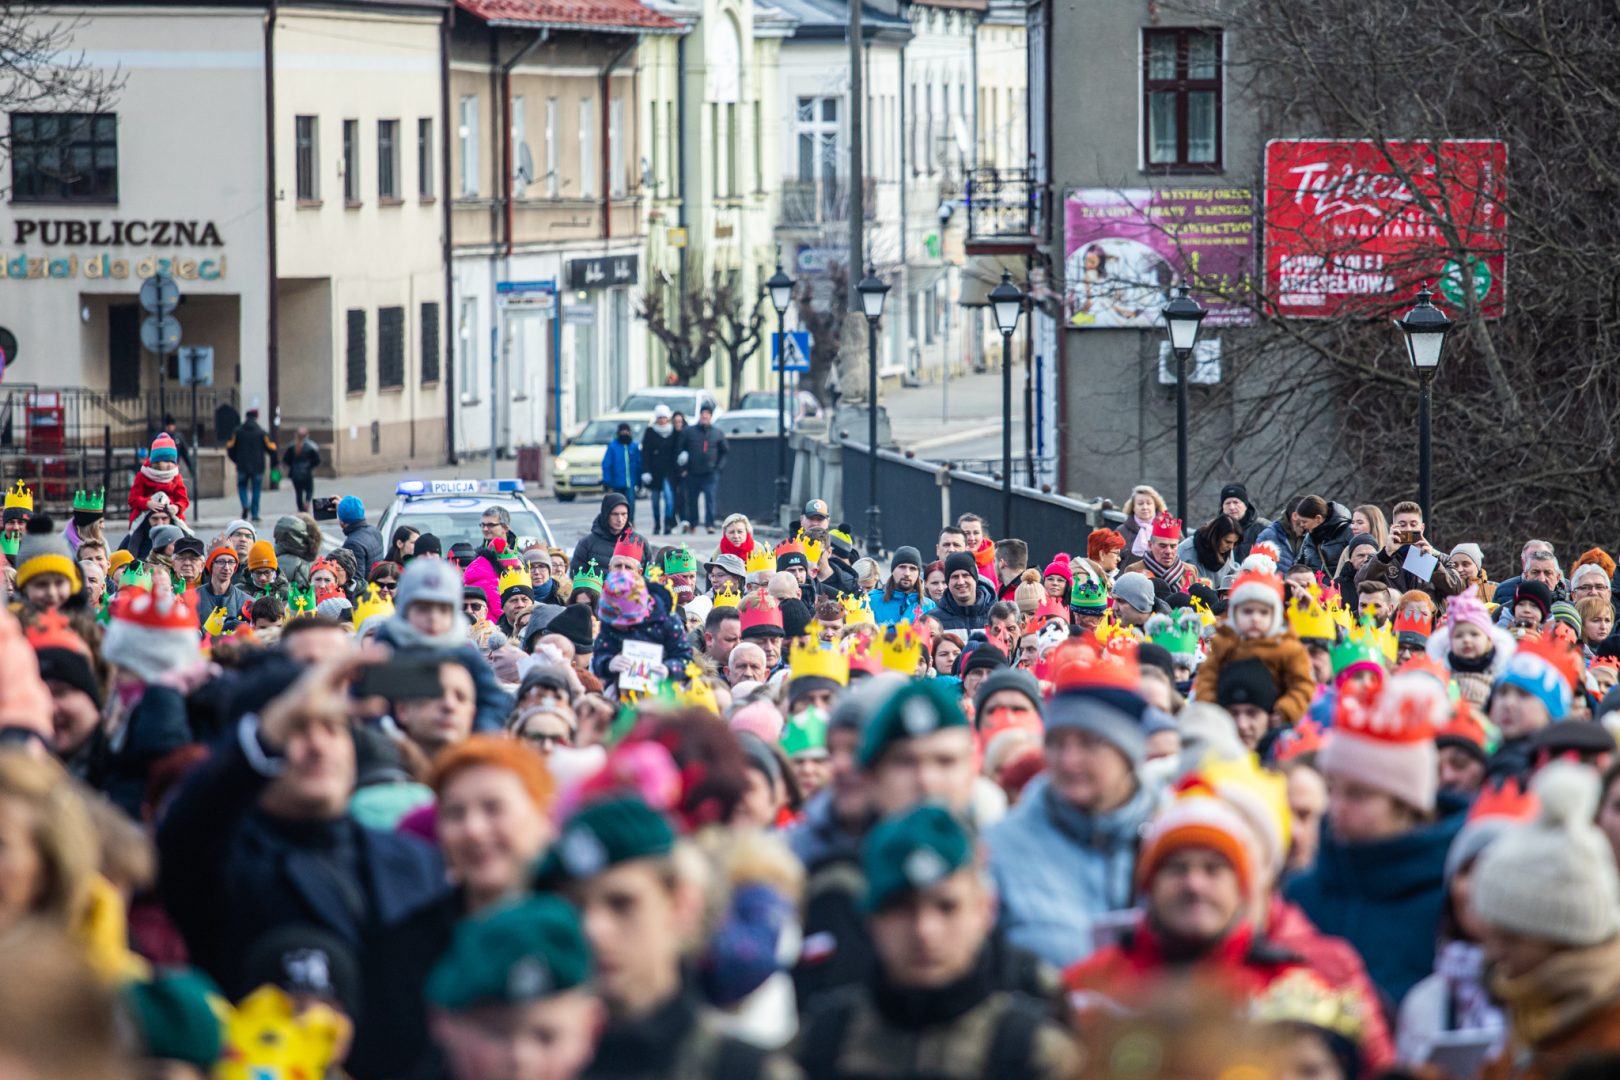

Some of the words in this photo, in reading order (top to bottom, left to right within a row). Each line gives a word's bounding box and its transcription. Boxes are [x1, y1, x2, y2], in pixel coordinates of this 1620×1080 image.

[14, 219, 224, 246] PUBLICZNA
[84, 253, 129, 279] dla
[137, 254, 226, 280] dzieci
[434, 483, 475, 492] POLICJA
